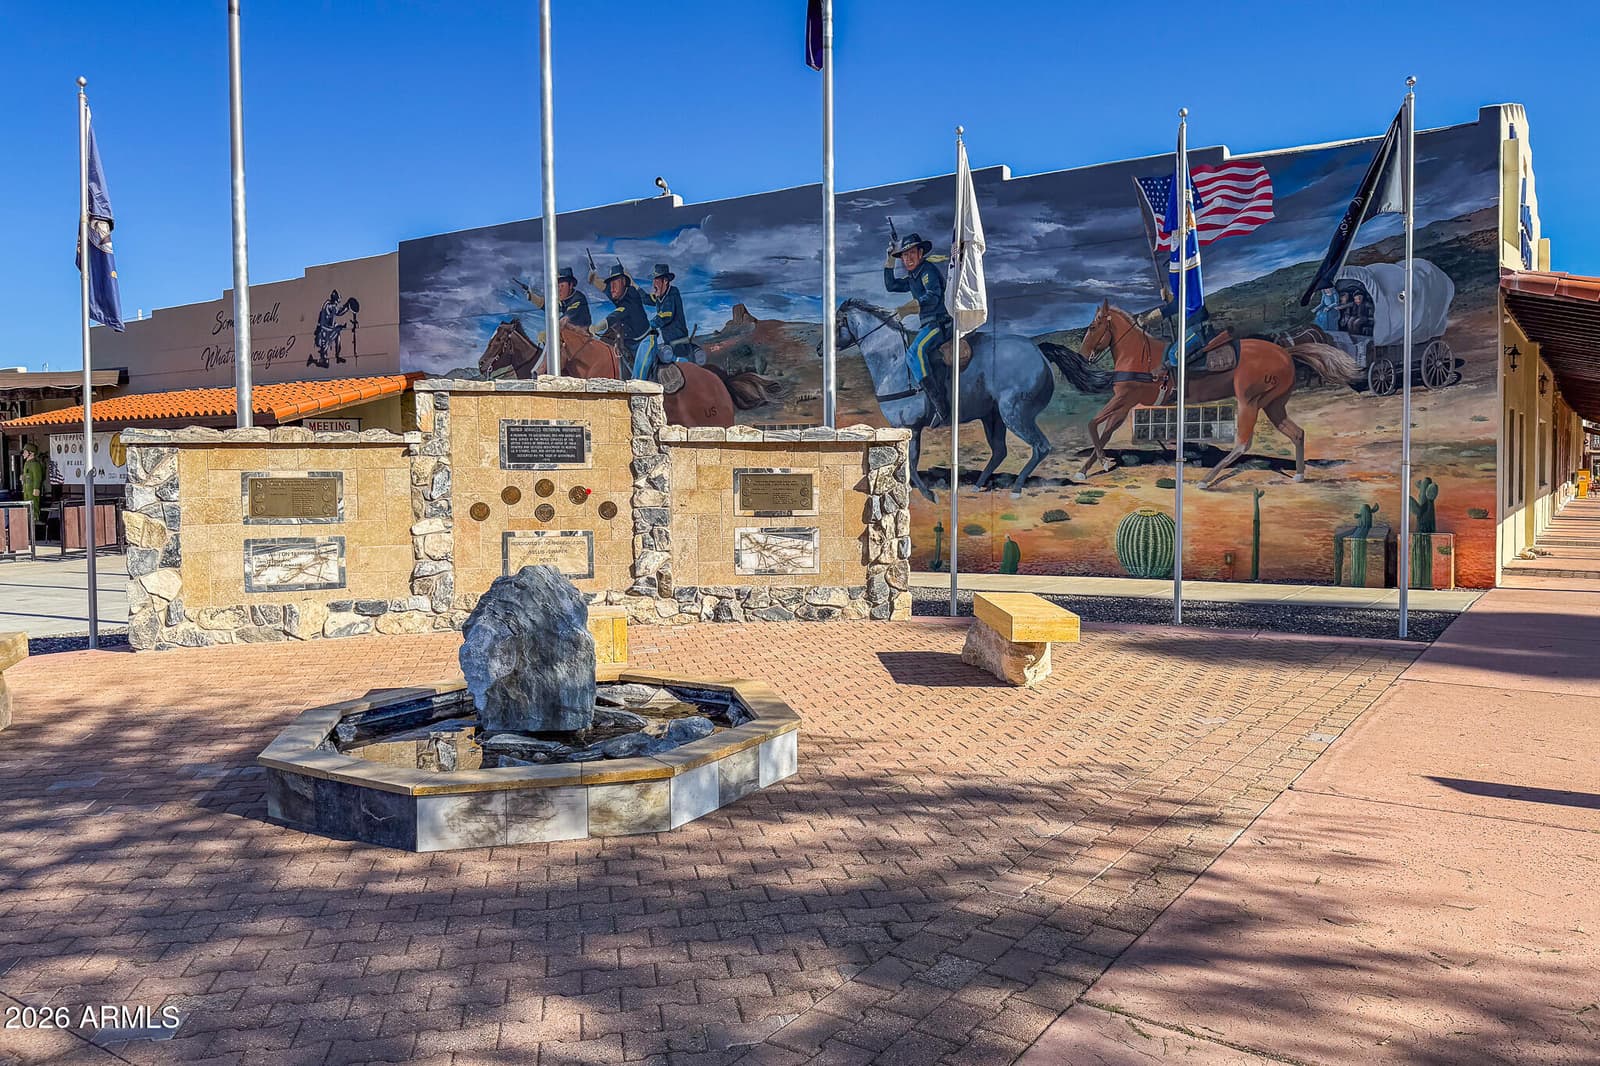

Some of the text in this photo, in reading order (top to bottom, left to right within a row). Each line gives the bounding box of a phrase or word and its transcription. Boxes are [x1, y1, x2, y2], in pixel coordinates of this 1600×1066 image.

[212, 310, 235, 335] Som
[263, 302, 280, 324] all,
[201, 345, 235, 372] What
[251, 350, 265, 361] ou
[265, 335, 296, 370] give?
[1264, 374, 1279, 385] US
[704, 406, 718, 418] US
[308, 421, 351, 431] MEETING
